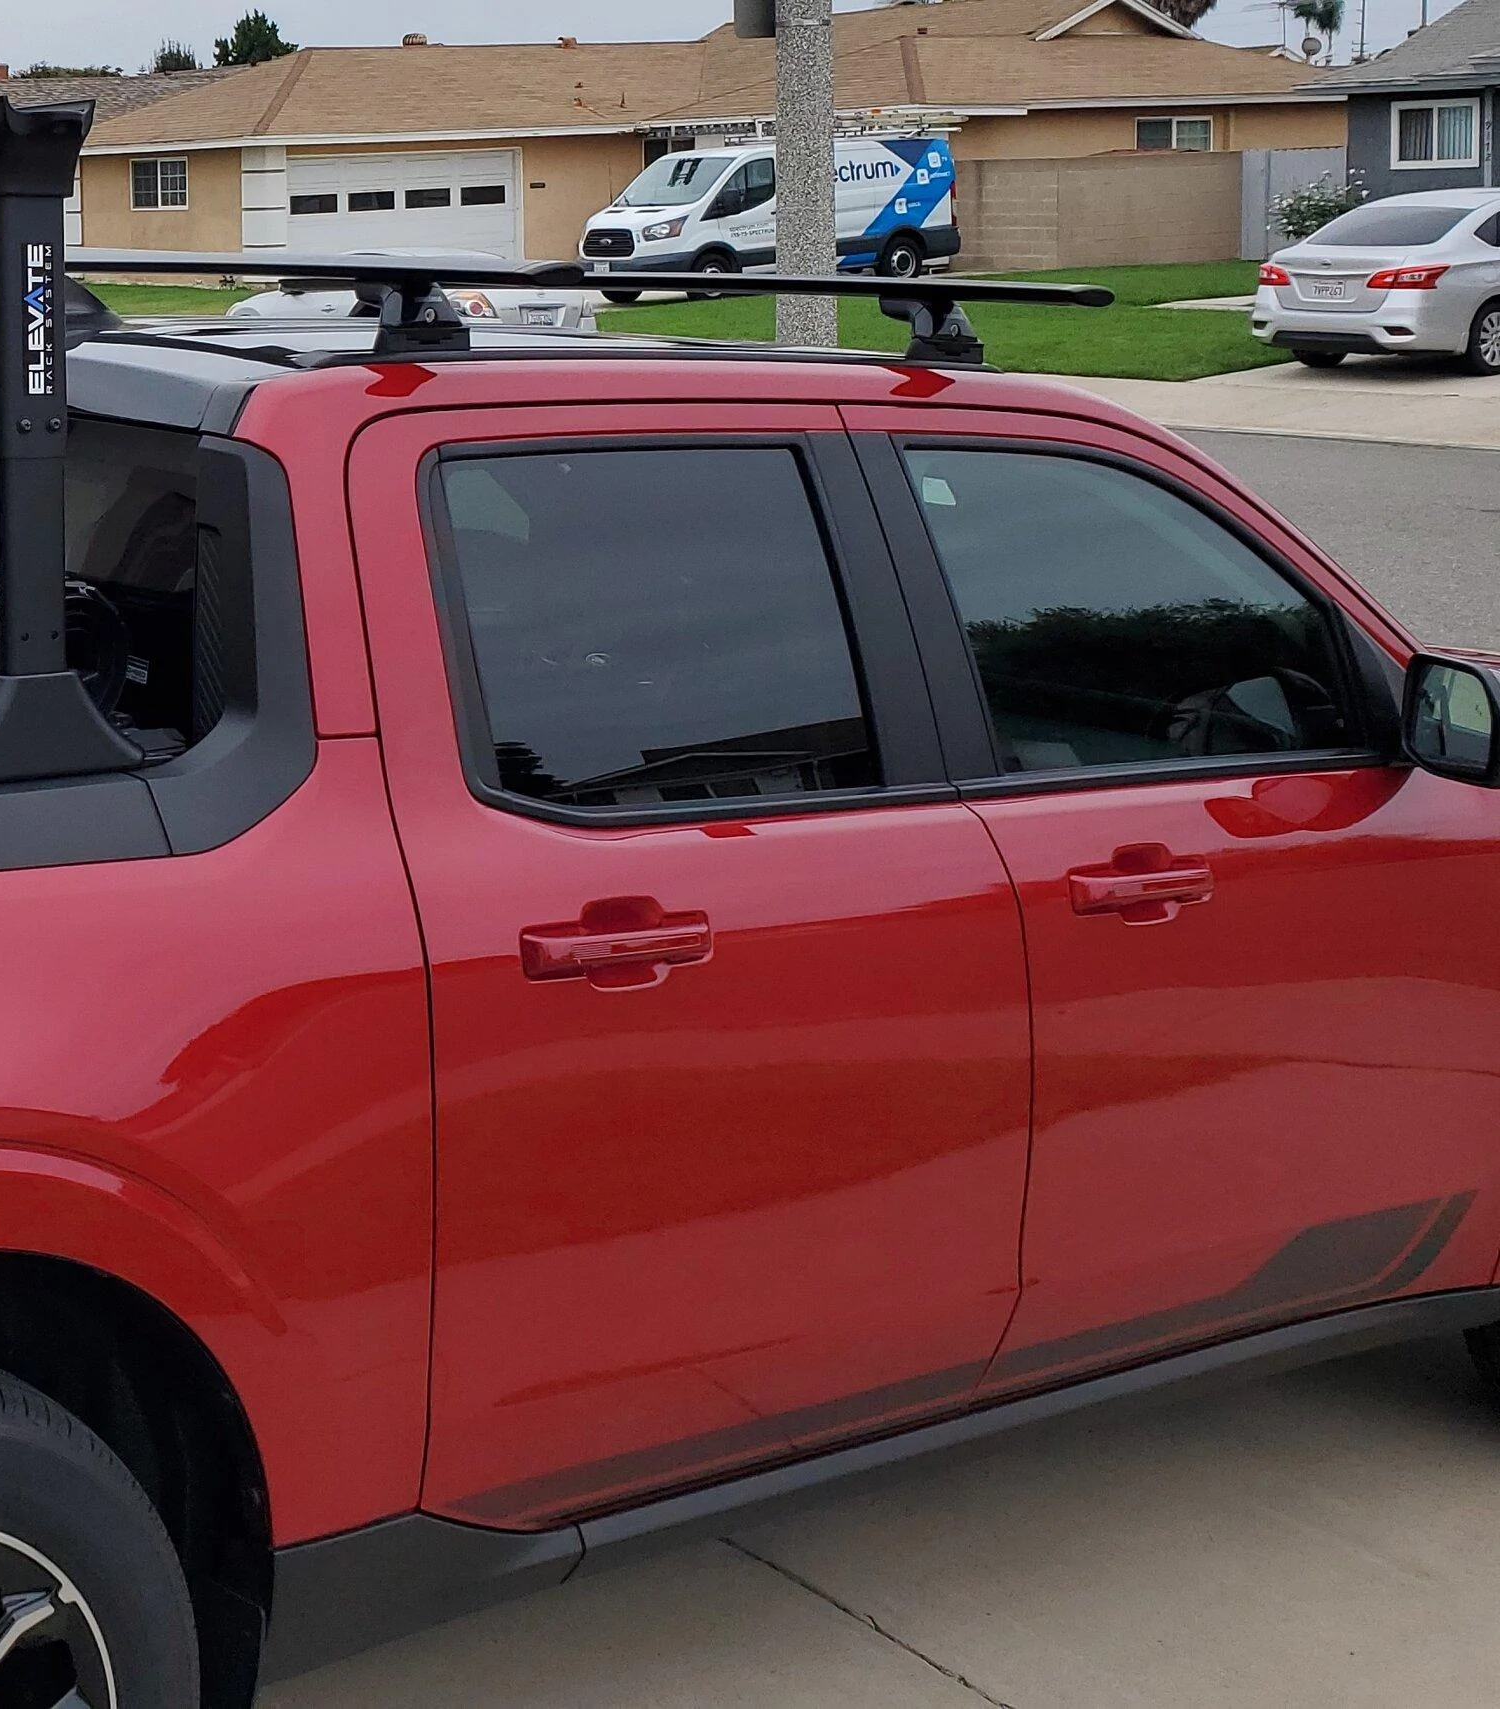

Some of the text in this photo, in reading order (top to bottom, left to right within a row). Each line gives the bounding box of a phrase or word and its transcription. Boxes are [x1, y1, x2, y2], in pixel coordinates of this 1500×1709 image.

[23, 244, 45, 394] ELEVATE
[45, 245, 53, 394] RACK SYSTEM
